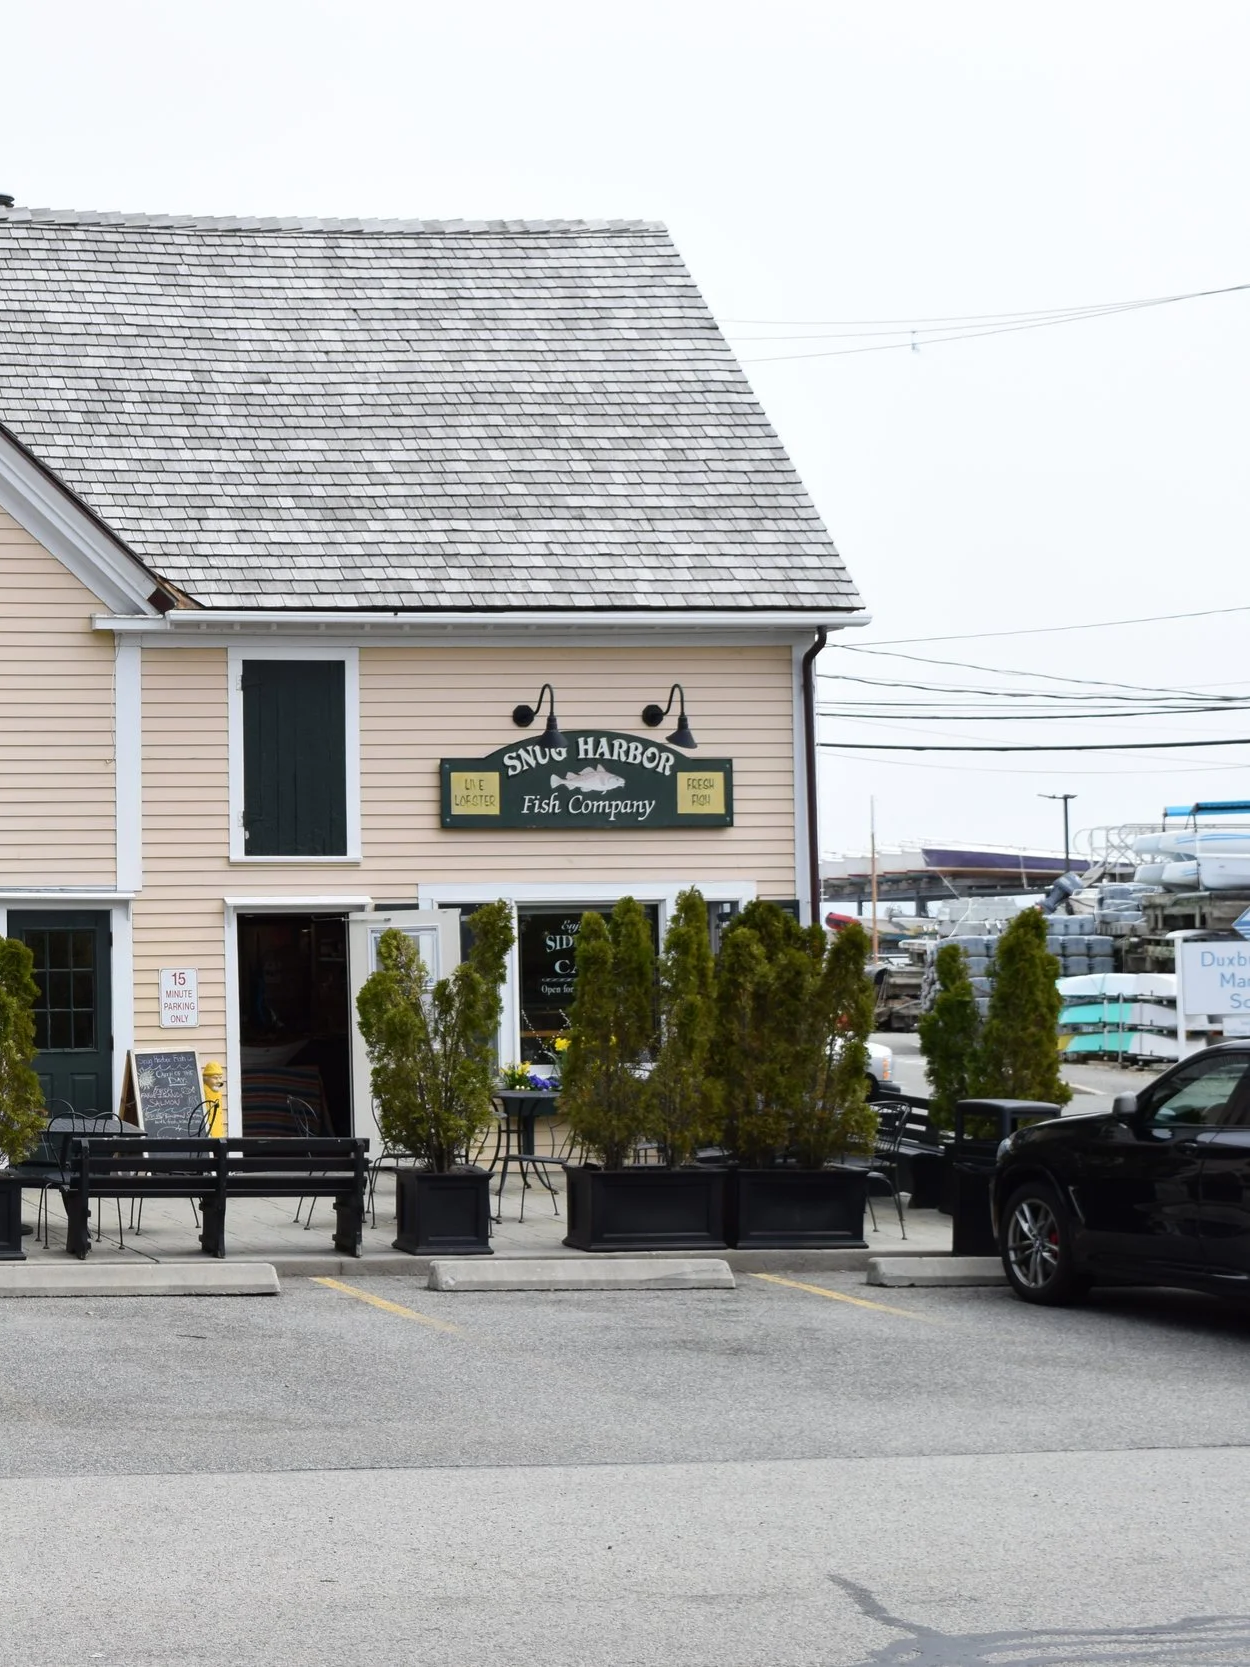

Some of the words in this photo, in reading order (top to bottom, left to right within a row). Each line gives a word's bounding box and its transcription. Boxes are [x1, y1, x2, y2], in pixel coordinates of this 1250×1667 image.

[503, 744, 568, 776] SNUG
[577, 736, 675, 776] HARBOR
[686, 777, 715, 790] FRESH
[691, 793, 711, 806] FISH
[521, 792, 562, 814] Fish
[567, 795, 656, 821] Company
[546, 935, 575, 953] SID
[1201, 950, 1250, 967] Duxb
[171, 973, 186, 986] 15
[166, 990, 192, 998] MINUTE
[541, 984, 561, 996] Open
[563, 984, 575, 993] for
[164, 1002, 195, 1010] PARKING
[170, 1015, 188, 1023] ONLY
